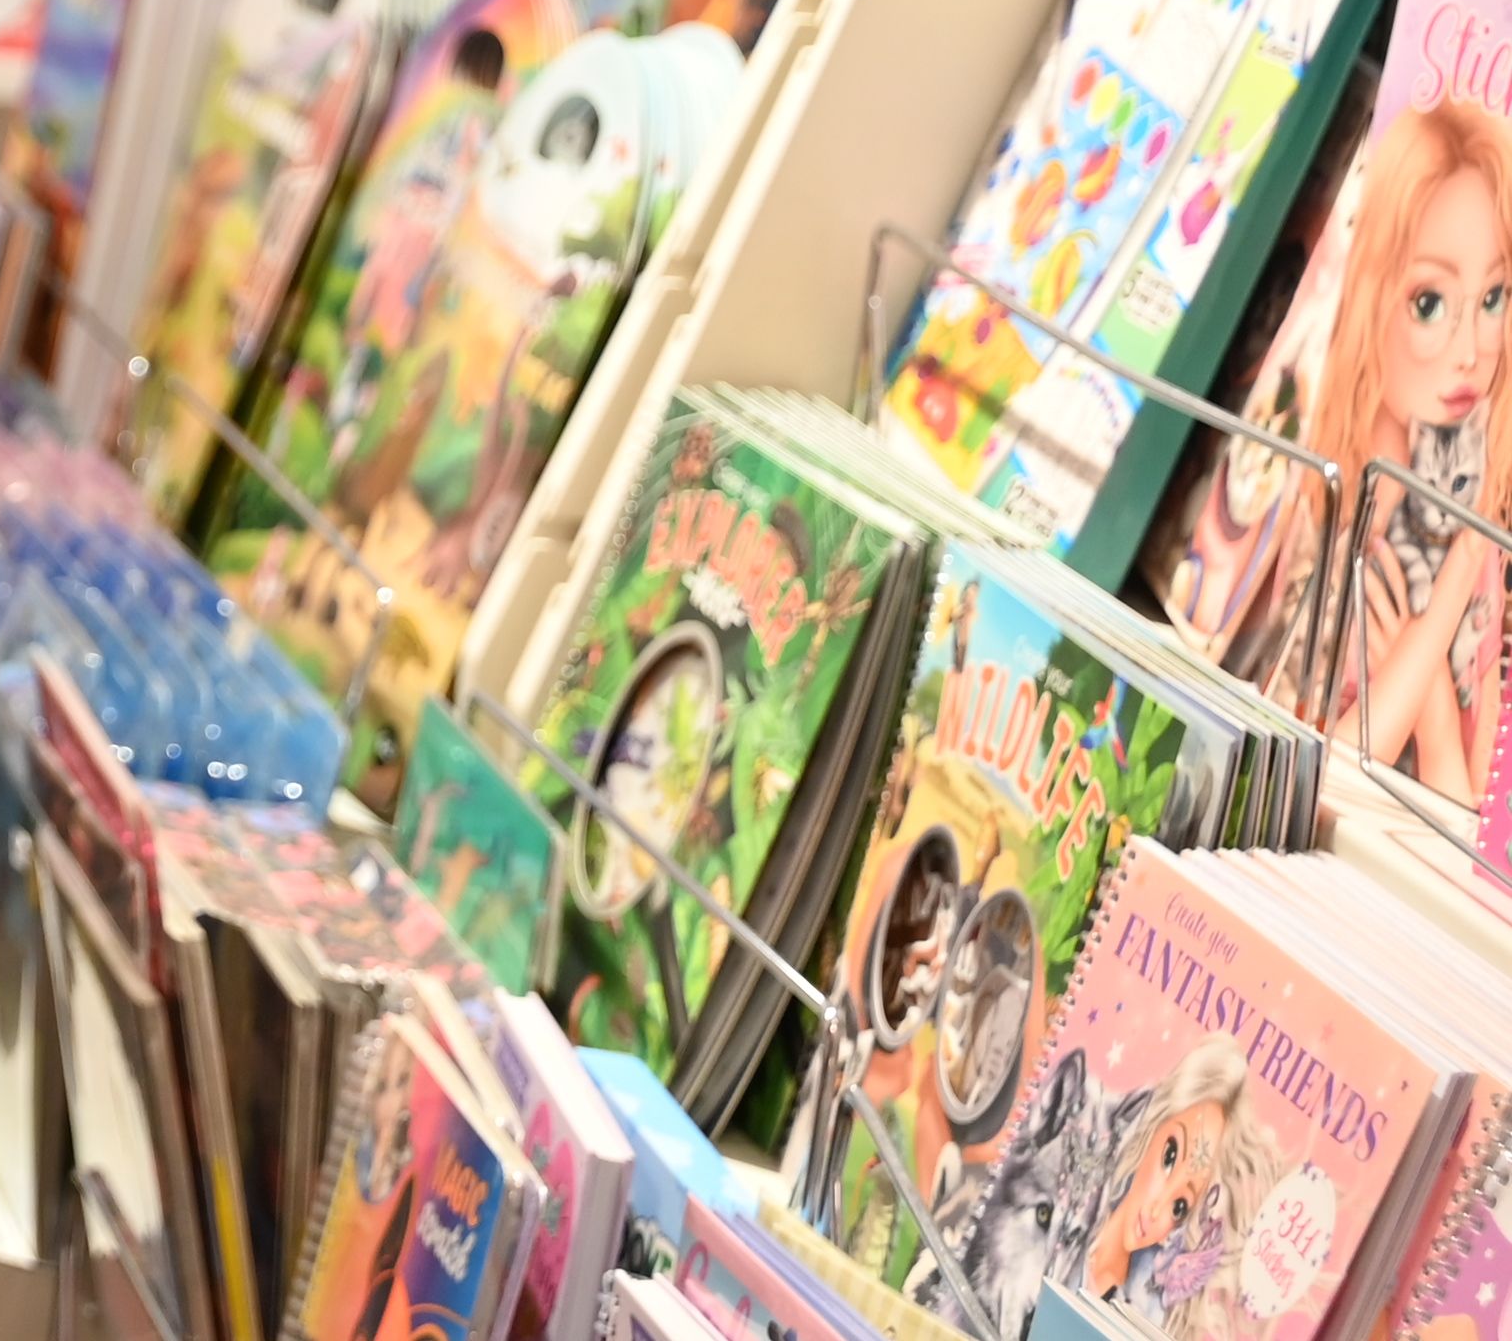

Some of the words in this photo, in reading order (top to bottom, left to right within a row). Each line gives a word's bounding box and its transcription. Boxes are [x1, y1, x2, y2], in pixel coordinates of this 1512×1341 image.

[1410, 1, 1512, 116] Stic
[933, 661, 1107, 883] WILDLIFE
[1113, 912, 1256, 1037] FANTASY
[1245, 1017, 1389, 1163] FRIENDS
